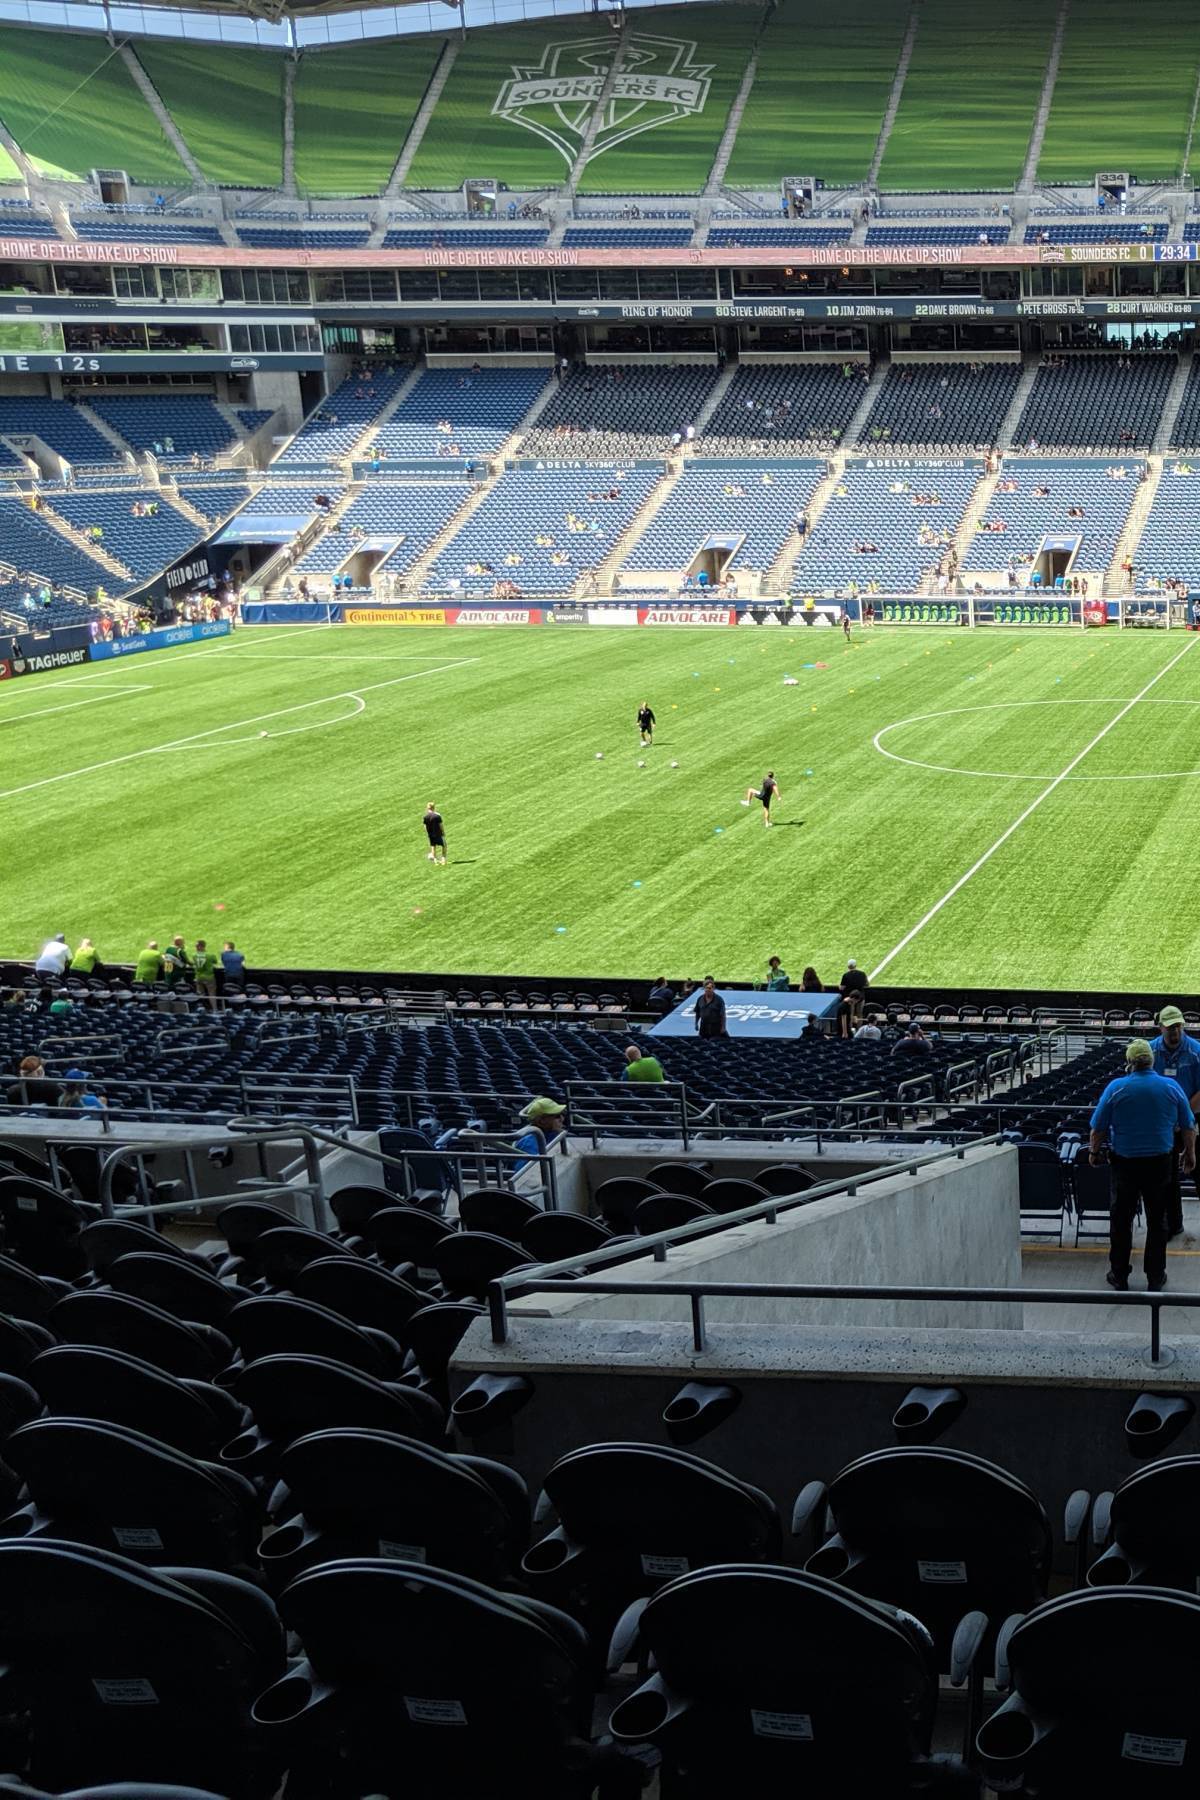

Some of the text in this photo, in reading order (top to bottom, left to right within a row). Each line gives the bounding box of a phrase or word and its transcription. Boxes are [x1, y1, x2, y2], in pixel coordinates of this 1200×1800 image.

[557, 76, 659, 87] SEATLE
[664, 87, 694, 102] FC
[1, 242, 178, 263] HOME OF THE WAKE UP SHOW
[424, 251, 578, 265] HOME OF THE WAKE UP SHOW
[812, 248, 962, 264] HOME OF THE WAKE UP SHOW
[1071, 248, 1118, 260] SOUNDERS
[1120, 248, 1130, 260] FC
[1140, 248, 1146, 260] 0
[1160, 246, 1190, 260] 29:34
[622, 306, 692, 318] RING OF HONOR
[716, 306, 730, 317] 80
[730, 306, 752, 317] STEVE
[754, 306, 788, 316] LARGENT
[826, 306, 839, 316] 10
[840, 306, 854, 316] JIM
[856, 306, 876, 316] ZORN
[915, 305, 928, 315] 22
[929, 305, 948, 315] DAVE
[948, 305, 977, 315] BROWN
[1023, 304, 1042, 314] PETE
[1042, 304, 1068, 314] GROSS
[1107, 304, 1120, 313] 28
[1121, 303, 1140, 314] CURT
[1142, 302, 1174, 314] WARNER
[54, 357, 100, 371] 12s
[547, 461, 581, 469] DELTA
[166, 559, 208, 589] FIELD CLUB
[350, 611, 443, 624] Continental TIRE
[462, 612, 528, 622] ADVOCARE
[556, 614, 583, 622] amperity
[648, 612, 728, 622] ADVOCARE
